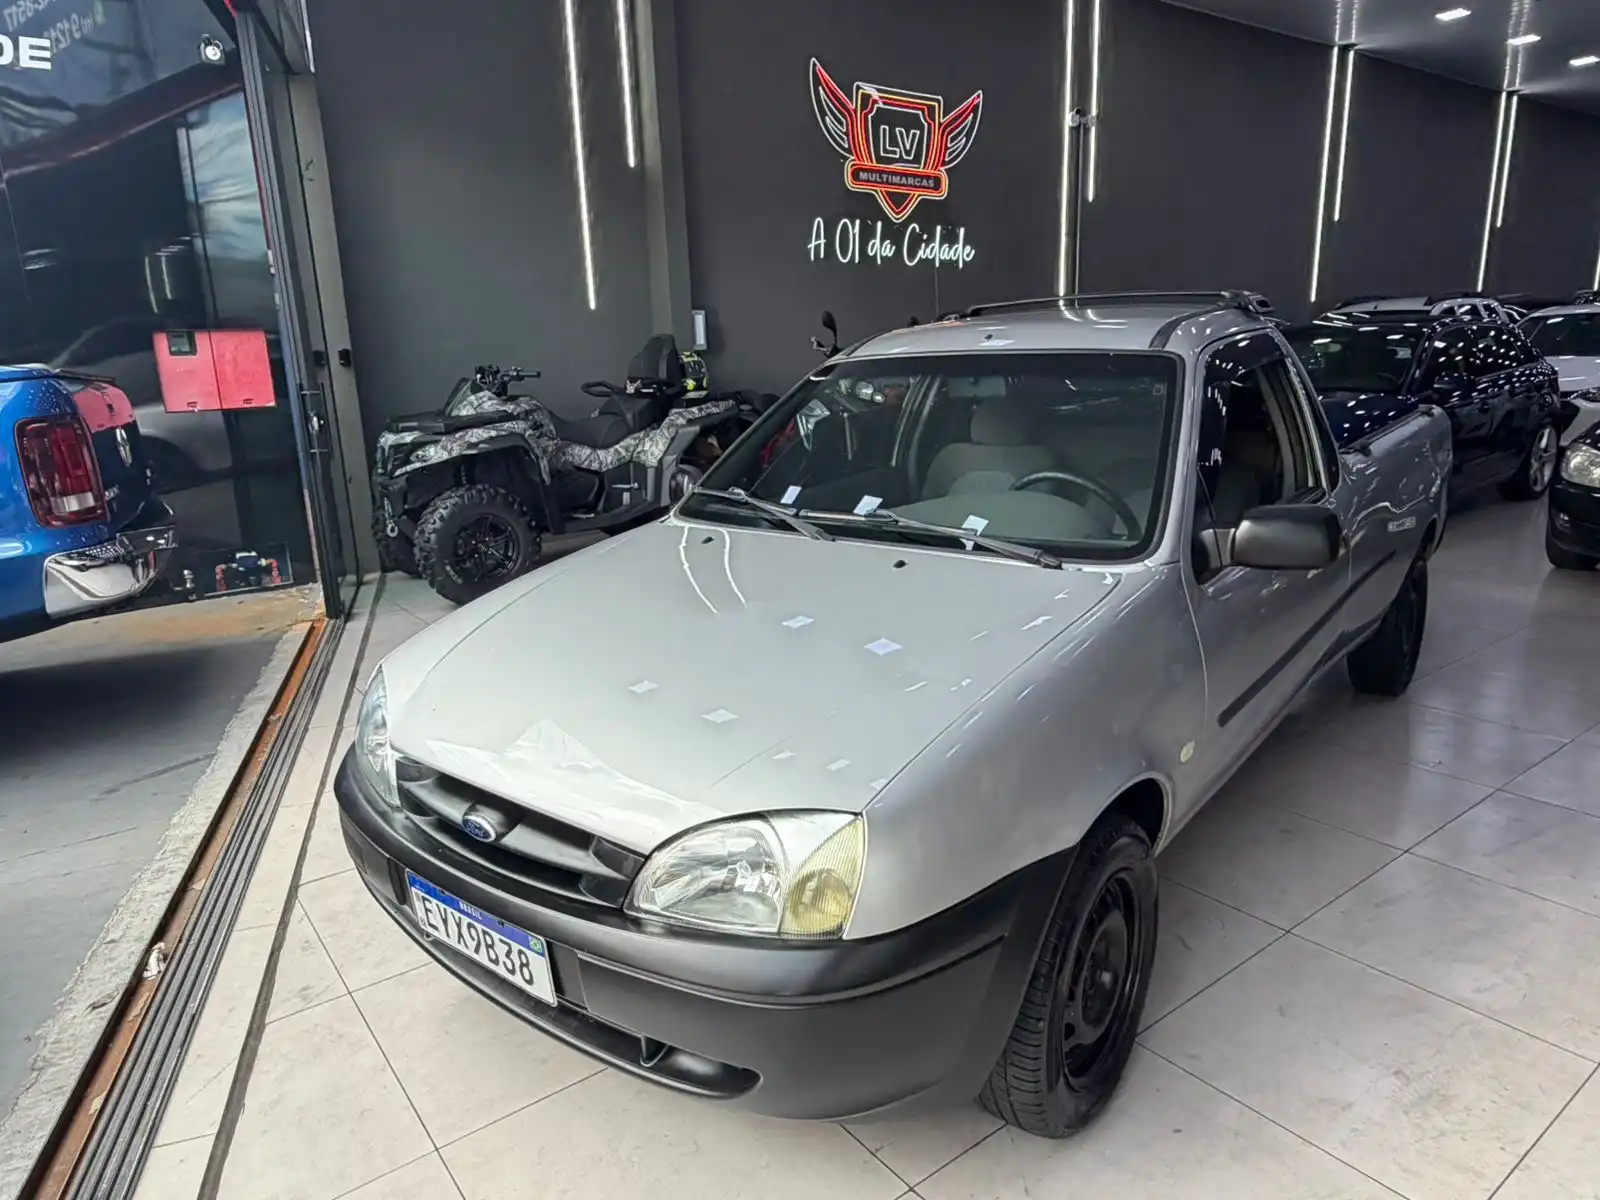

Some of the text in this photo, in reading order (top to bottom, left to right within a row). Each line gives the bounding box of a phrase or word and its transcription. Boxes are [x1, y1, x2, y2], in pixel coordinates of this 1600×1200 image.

[880, 125, 920, 160] LV
[858, 171, 935, 188] MULTIMARCAS
[807, 217, 827, 262] A
[867, 220, 896, 265] da
[903, 223, 976, 269] Cidade
[422, 895, 535, 987] EYX9B38
